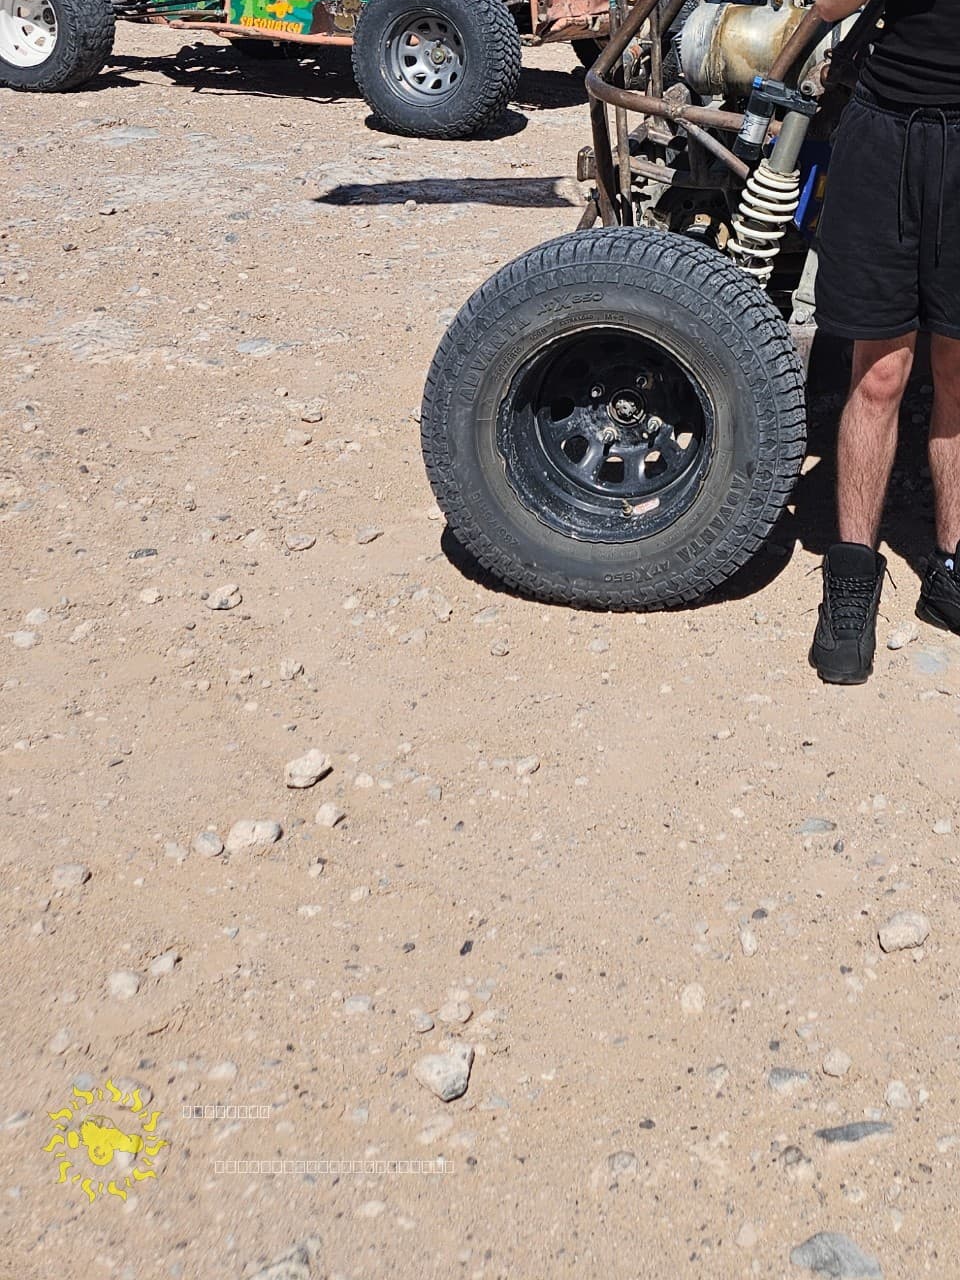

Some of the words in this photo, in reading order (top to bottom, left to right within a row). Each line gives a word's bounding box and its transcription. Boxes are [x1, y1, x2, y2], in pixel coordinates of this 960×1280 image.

[239, 16, 303, 34] SASQUATCH
[459, 317, 532, 402] ADVANTA
[675, 471, 747, 564] ADVANTA
